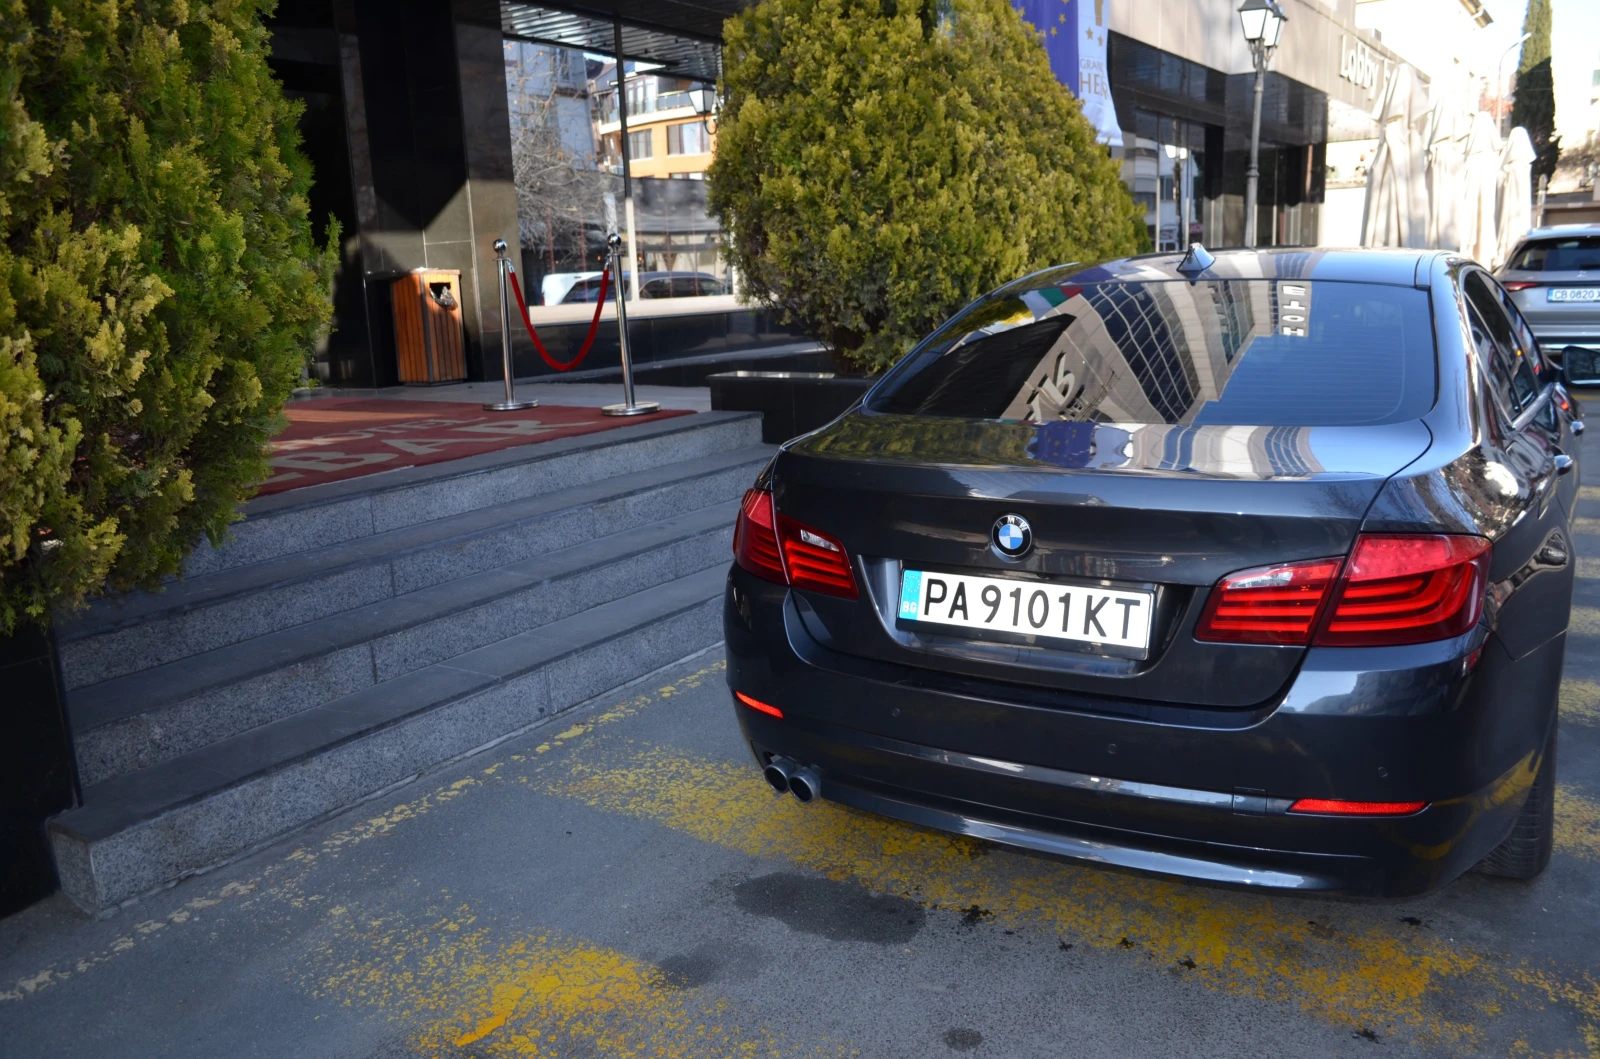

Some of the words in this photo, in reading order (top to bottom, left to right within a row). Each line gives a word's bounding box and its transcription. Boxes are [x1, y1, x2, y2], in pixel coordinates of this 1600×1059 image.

[1338, 34, 1379, 101] Lobby
[995, 515, 1029, 531] BMW
[902, 600, 918, 614] BG
